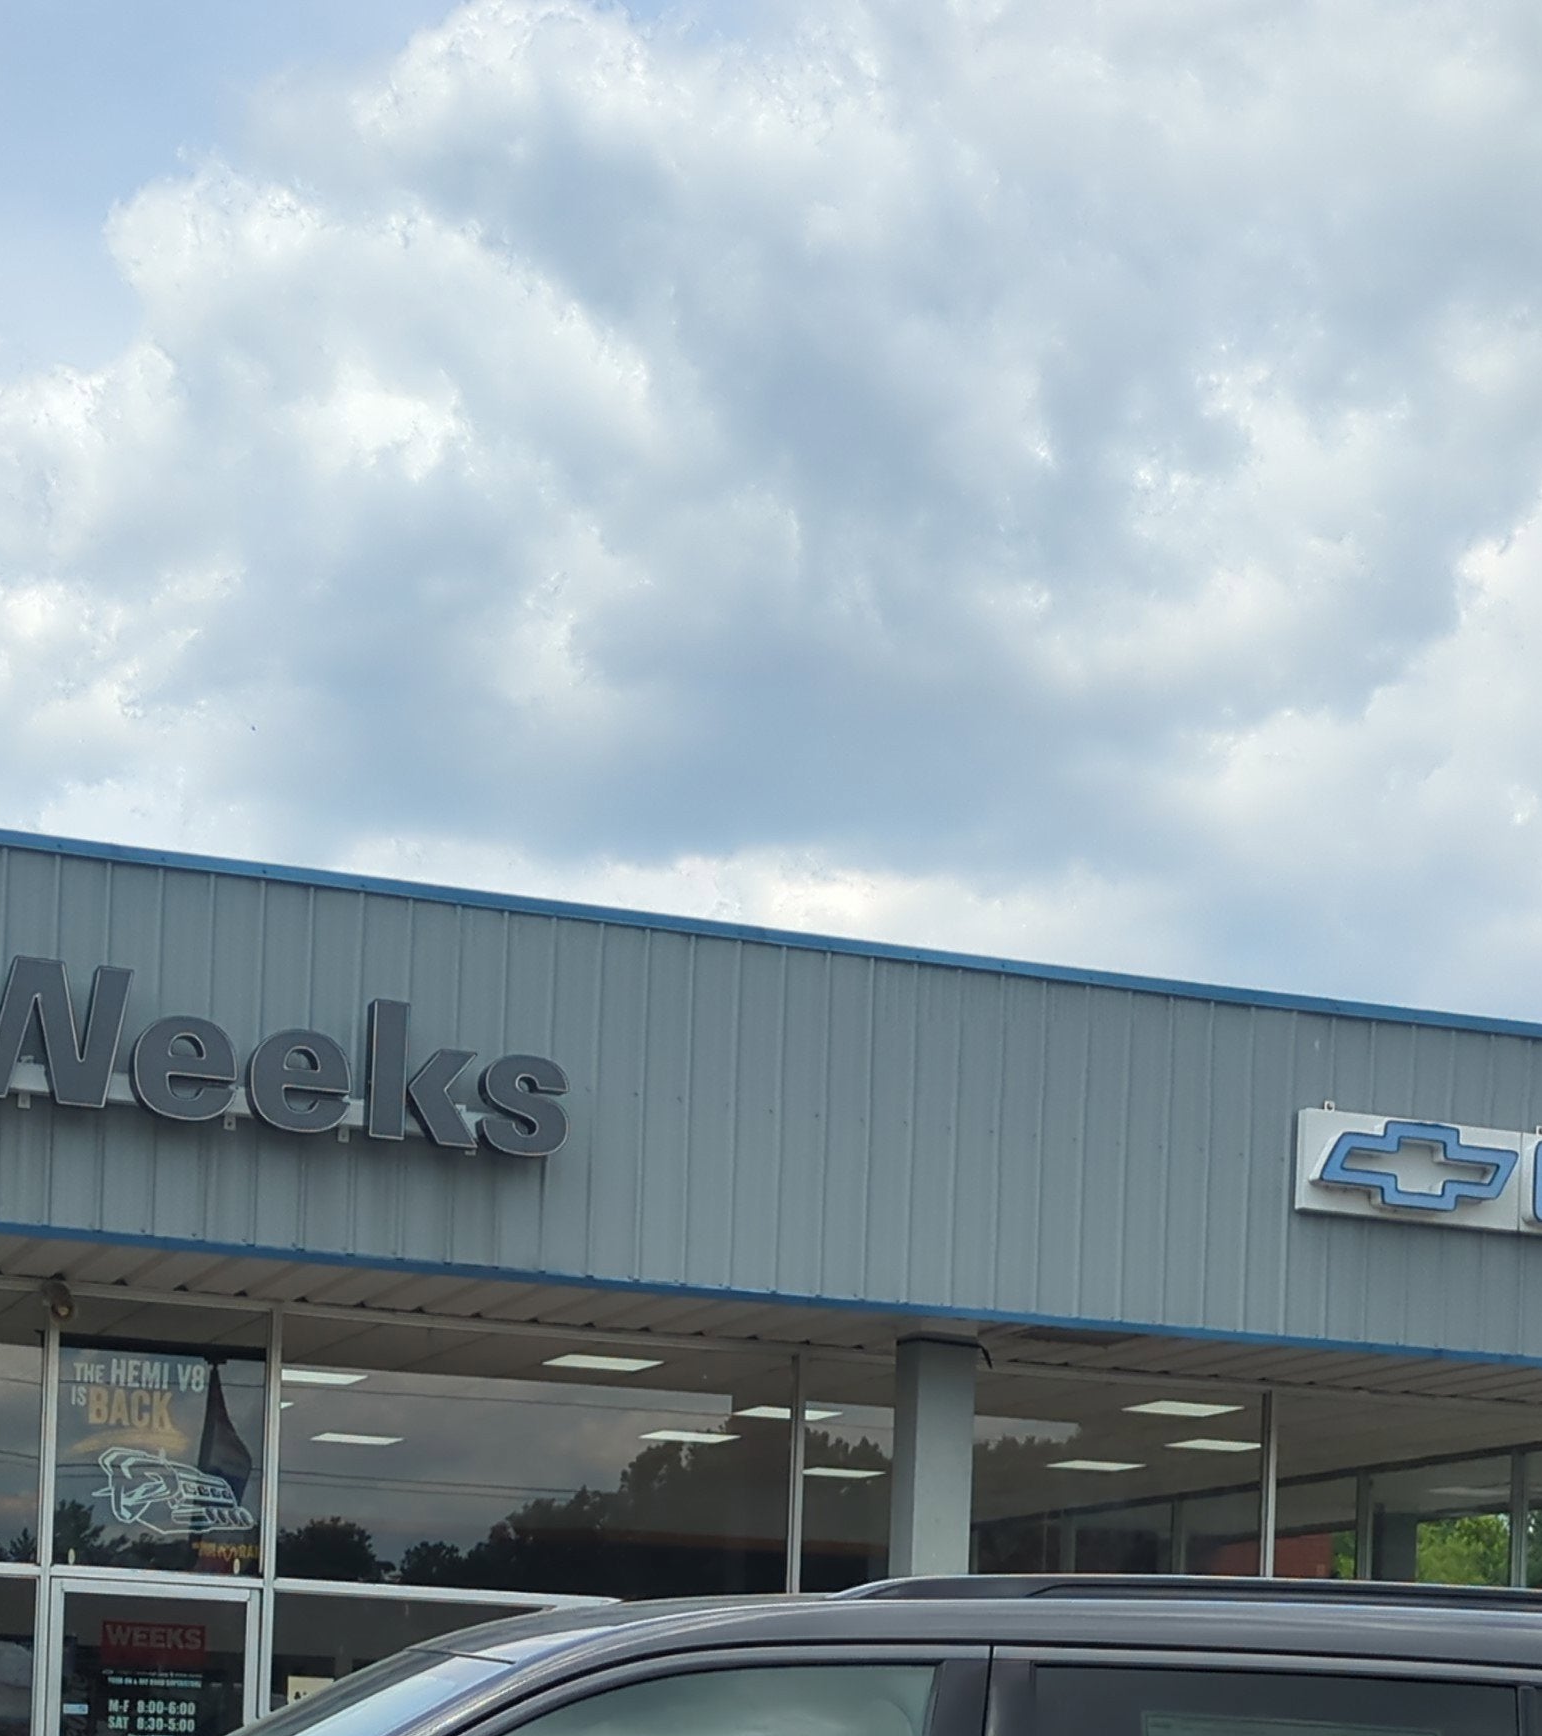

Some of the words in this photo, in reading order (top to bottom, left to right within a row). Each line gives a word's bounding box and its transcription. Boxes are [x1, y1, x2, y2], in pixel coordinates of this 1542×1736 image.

[73, 1361, 106, 1384] THE
[110, 1358, 169, 1391] HEMI
[177, 1363, 206, 1393] V8
[71, 1385, 87, 1406] IS
[88, 1386, 173, 1430] BACK
[105, 1624, 202, 1650] WEEKS
[108, 1699, 130, 1713] M-F
[107, 1715, 130, 1730] SAT
